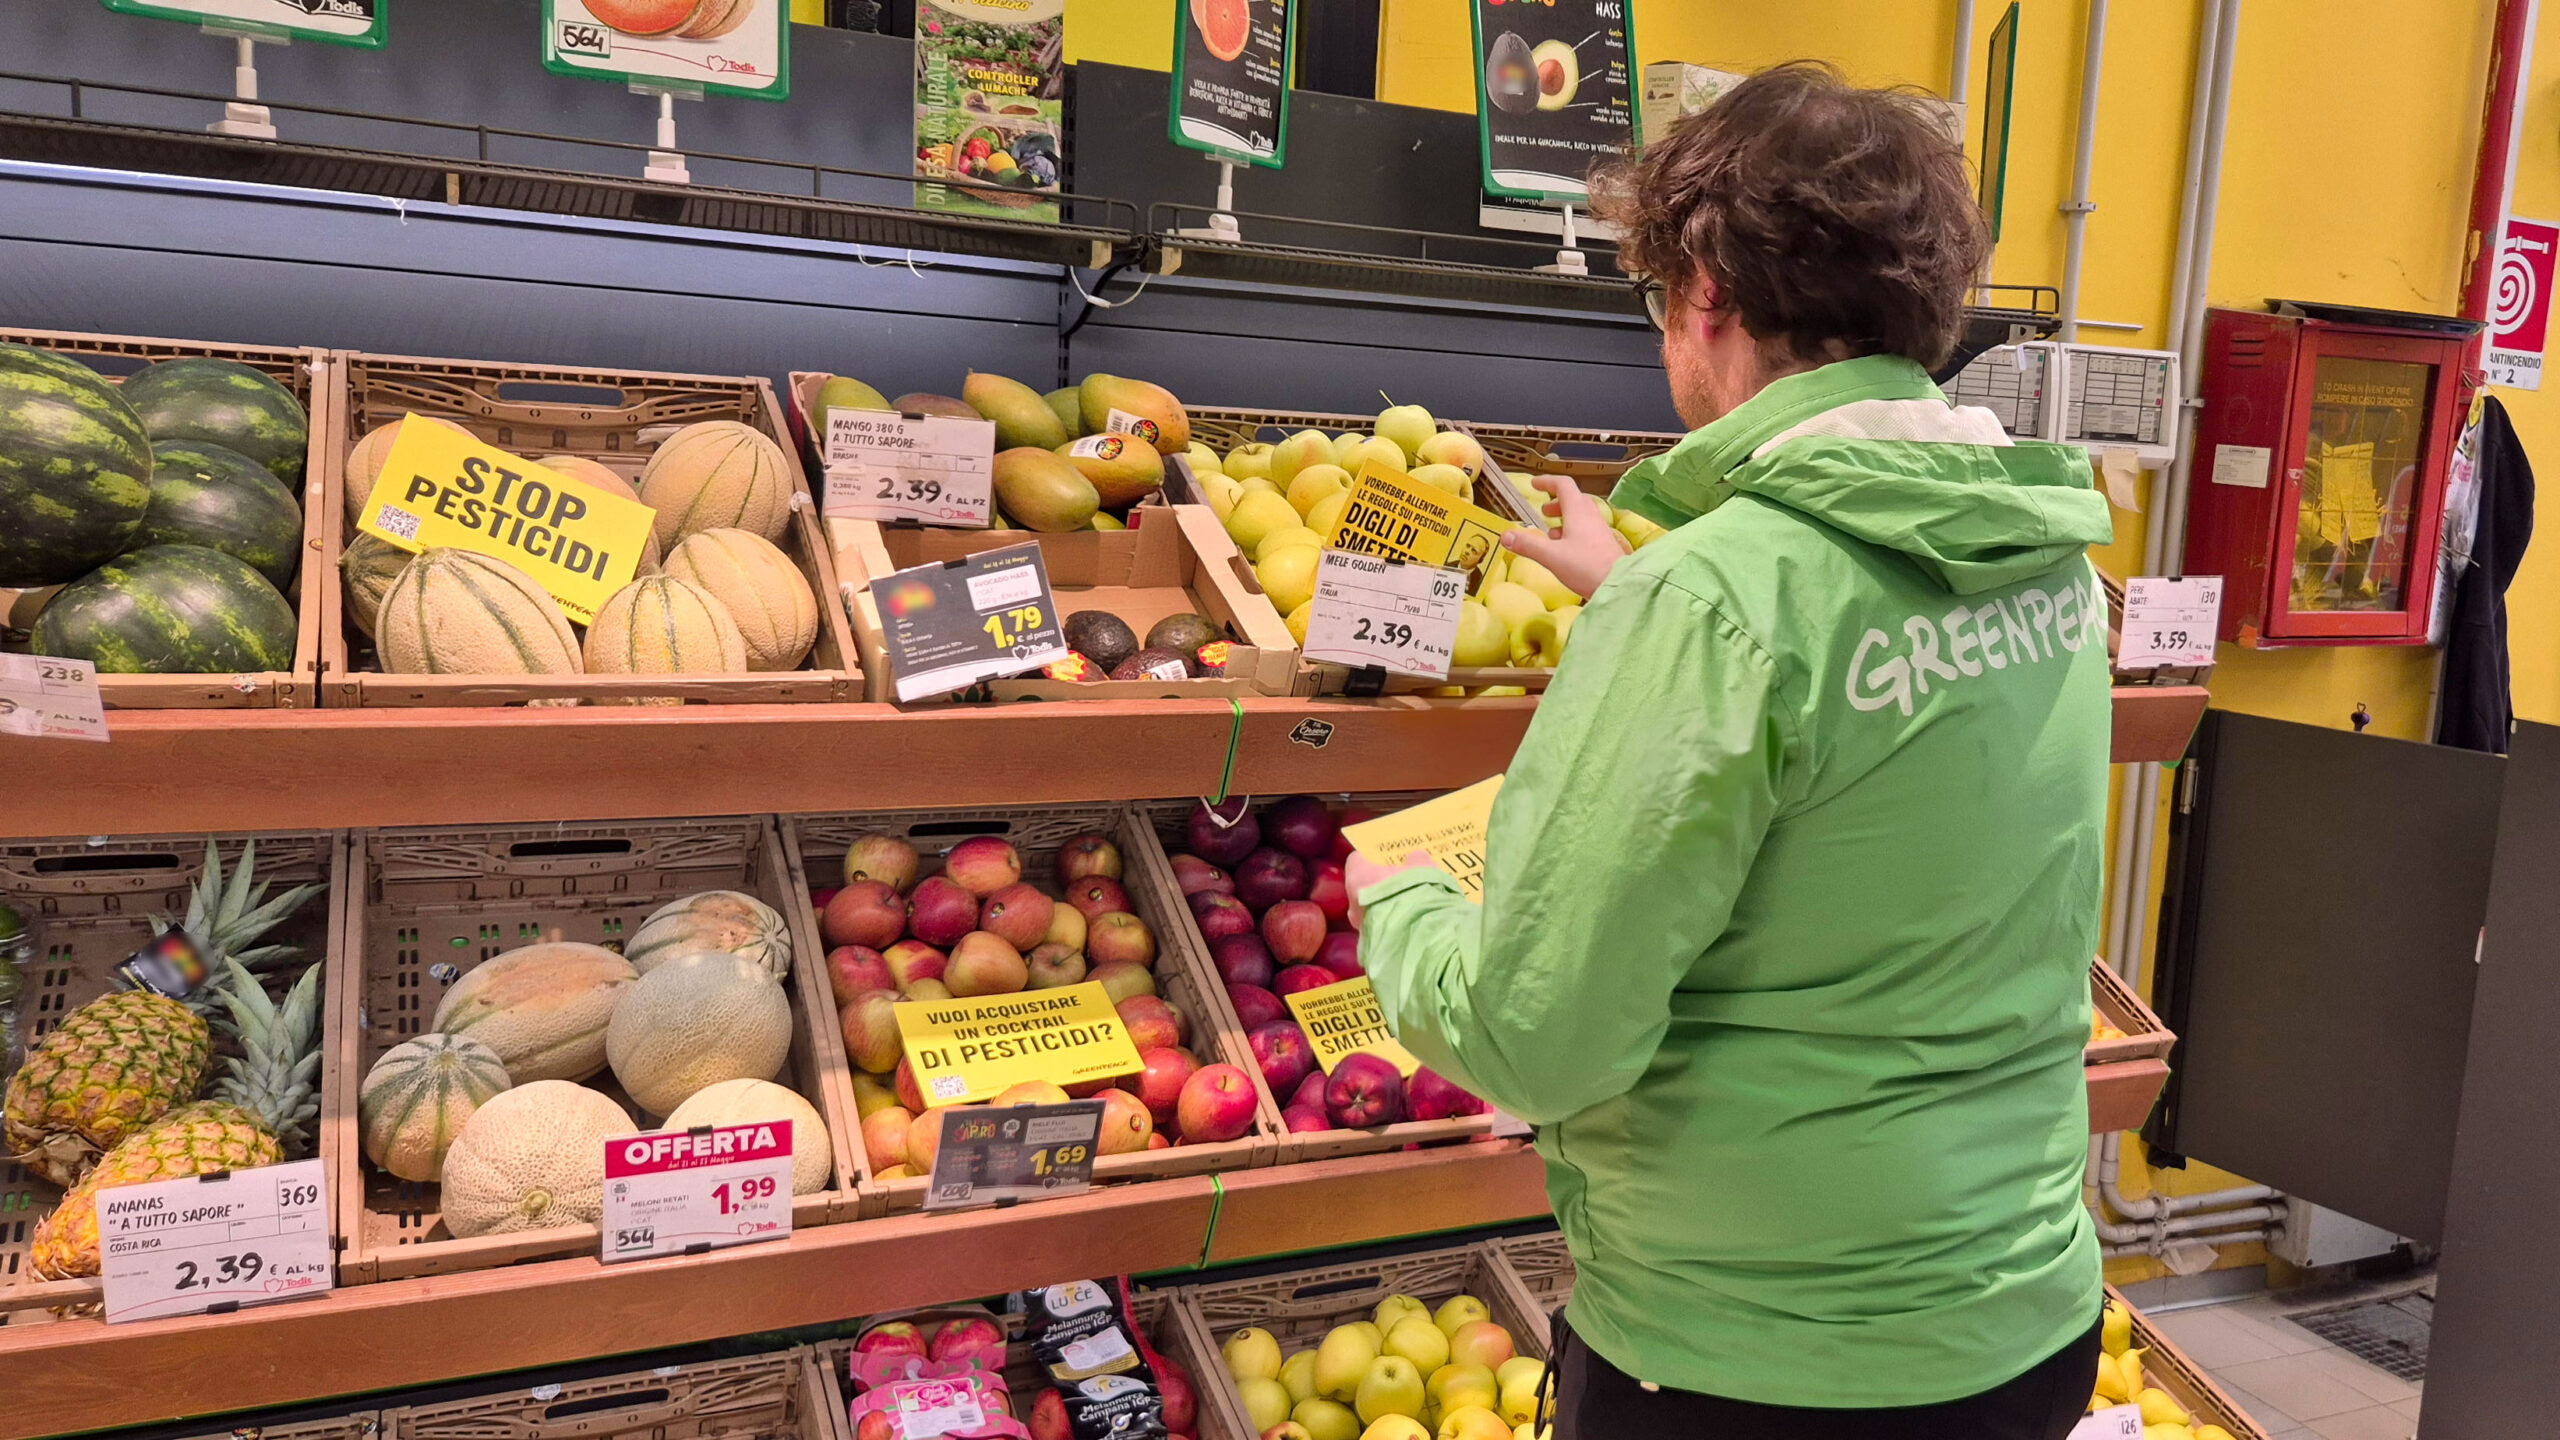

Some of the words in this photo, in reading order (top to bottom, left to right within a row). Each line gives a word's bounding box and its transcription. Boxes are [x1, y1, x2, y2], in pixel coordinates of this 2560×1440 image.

[327, 0, 364, 15] Todis
[1595, 2, 1621, 19] HASS
[563, 26, 604, 52] 564
[729, 61, 755, 72] Todis
[968, 69, 1039, 86] CONTROLLER
[927, 52, 948, 141] NATURALE
[980, 82, 1027, 96] LUMACHE
[1495, 134, 1515, 144] IDEALE
[1516, 135, 1528, 145] PER
[1529, 136, 1537, 145] LA
[1537, 137, 1573, 149] GUACAMOLE,
[2489, 352, 2541, 369] ANTINCENDIO
[2505, 368, 2515, 384] 2
[833, 419, 872, 431] MANGO
[876, 423, 893, 434] 380
[897, 425, 904, 435] G
[833, 433, 840, 443] A
[844, 434, 874, 446] TUTTO
[878, 437, 914, 448] SAPORE
[455, 456, 587, 529] STOP
[876, 477, 942, 504] 2,39
[945, 492, 951, 503] €
[1365, 475, 1407, 500] VORREBBE
[1406, 494, 1449, 520] ALLENTARE
[1357, 489, 1367, 500] LE
[1369, 493, 1399, 514] REGOLE
[1400, 507, 1414, 521] SUI
[1414, 513, 1452, 538] PESTICIDI
[404, 474, 610, 582] PESTICIDI
[1345, 502, 1397, 540] DIGLI
[1395, 524, 1419, 550] DI
[1325, 554, 1349, 568] MELE
[1351, 559, 1387, 574] GOLDEN
[1433, 580, 1459, 599] 095
[2201, 592, 2215, 604] 130
[2129, 597, 2147, 605] ABATE
[983, 606, 1042, 649] 1,79
[1033, 629, 1055, 641] pezzo
[1353, 617, 1412, 649] 2,39
[1414, 639, 1421, 649] €
[1423, 644, 1435, 653] AL
[1438, 646, 1449, 656] kg
[2150, 631, 2188, 650] 3,59
[41, 666, 84, 682] 238
[926, 1011, 971, 1024] VUOI
[976, 995, 1081, 1021] ACQUISTARE
[1299, 995, 1345, 1010] VORREBBE
[1304, 1011, 1314, 1020] LE
[1316, 1004, 1349, 1017] REGOLE
[1350, 999, 1367, 1009] SUI
[953, 1027, 980, 1041] UN
[985, 1014, 1070, 1036] COCKTAIL
[1309, 1011, 1364, 1037] DIGLI
[919, 1047, 952, 1070] DI
[959, 1022, 1115, 1065] PESTICIDI?
[1071, 1060, 1130, 1075] GREENPEACE
[624, 1126, 777, 1166] OFFERTA
[668, 1161, 680, 1169] dal
[710, 1155, 735, 1166] Maggio
[1030, 1145, 1087, 1177] 1,69
[107, 1197, 164, 1215] ANANAS
[280, 1184, 318, 1207] 369
[631, 1199, 662, 1208] MELONI
[663, 1195, 690, 1204] RETATI
[711, 1176, 777, 1215] 1,99
[121, 1217, 130, 1231] A
[135, 1212, 177, 1228] TUTTO
[182, 1205, 232, 1222] SAPORE
[756, 1222, 777, 1232] Todis
[109, 1242, 138, 1253] COSTA
[141, 1238, 161, 1248] RICA
[618, 1229, 654, 1246] 564
[175, 1252, 264, 1290] 2,39
[269, 1264, 278, 1275] €
[286, 1266, 303, 1274] AL
[308, 1264, 325, 1273] kg
[286, 1278, 312, 1287] Todis
[1043, 1325, 1092, 1343] Campana
[1093, 1314, 1112, 1328] IGP
[1047, 1310, 1107, 1334] Melannurca
[1080, 1402, 1131, 1422] Campana
[1132, 1396, 1151, 1408] IGP
[1083, 1392, 1144, 1414] Melannurca
[2121, 1419, 2137, 1435] 126
